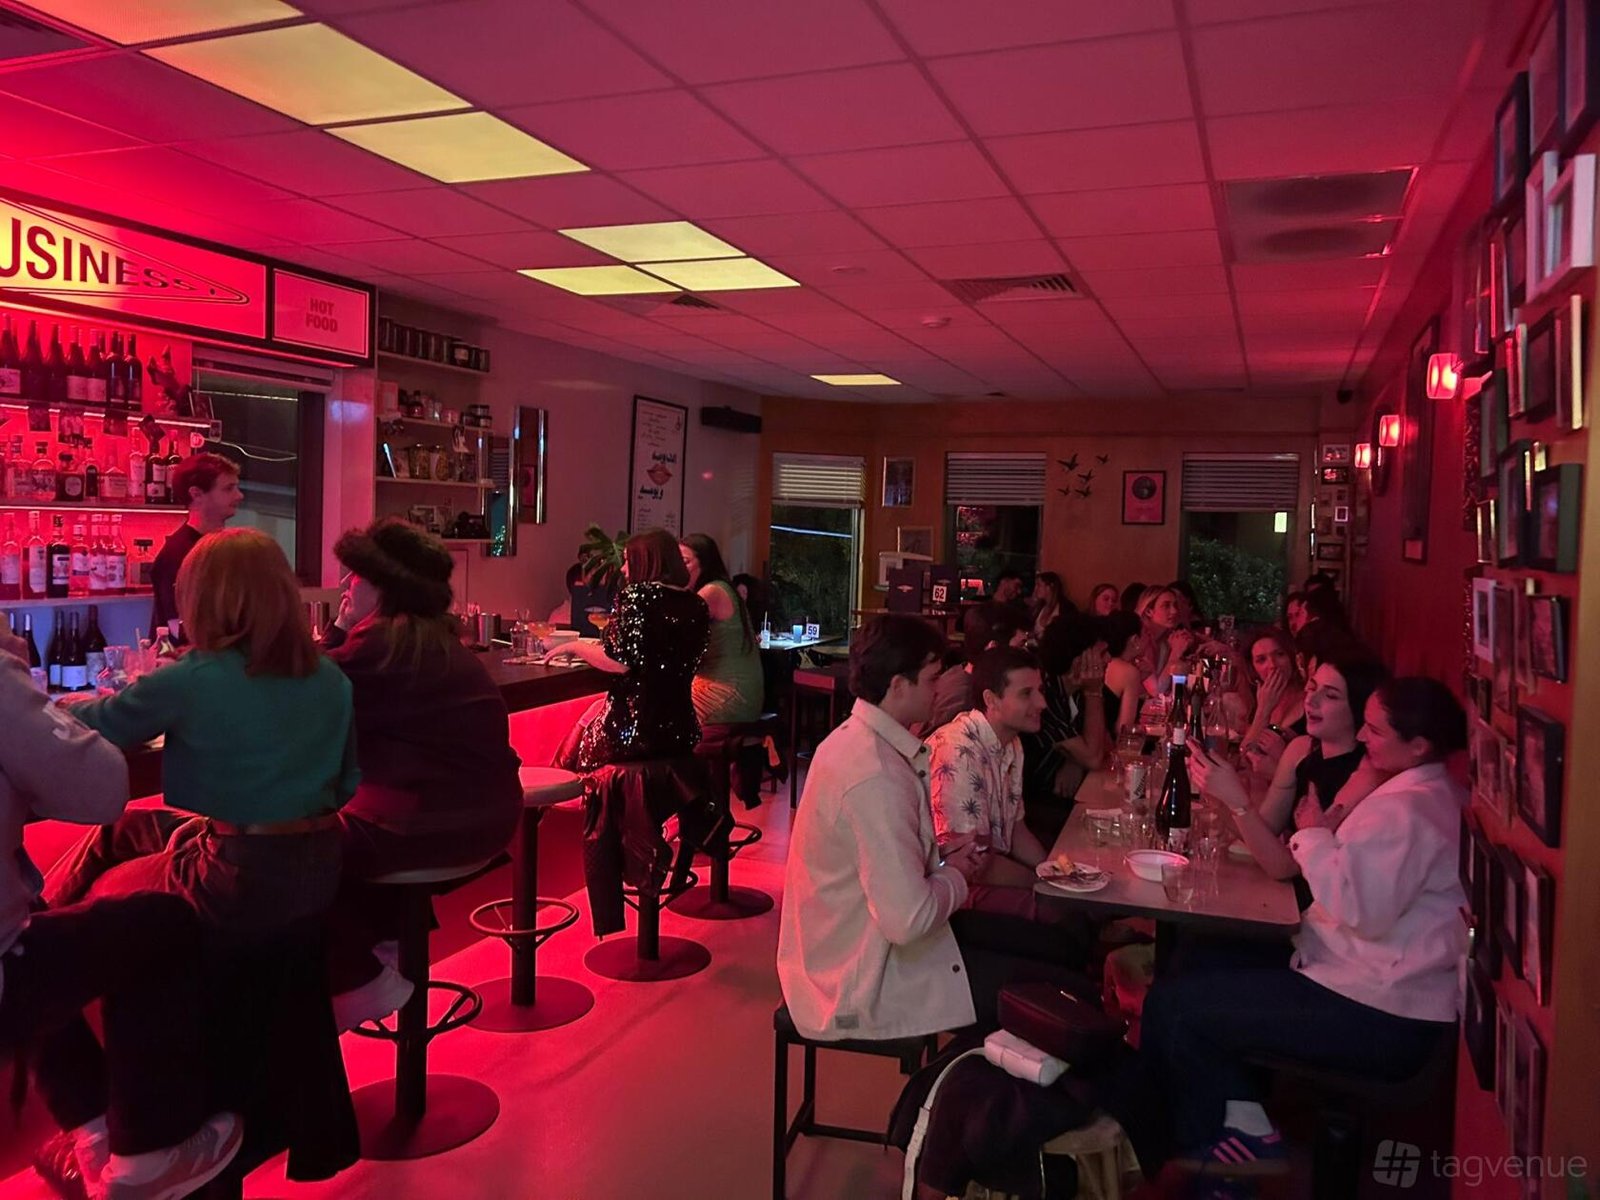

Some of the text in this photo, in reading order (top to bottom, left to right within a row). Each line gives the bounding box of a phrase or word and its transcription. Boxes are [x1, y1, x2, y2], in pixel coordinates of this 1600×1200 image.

[308, 296, 335, 316] HOT
[305, 311, 338, 333] FOOD
[934, 587, 945, 600] 62
[807, 625, 818, 635] 59
